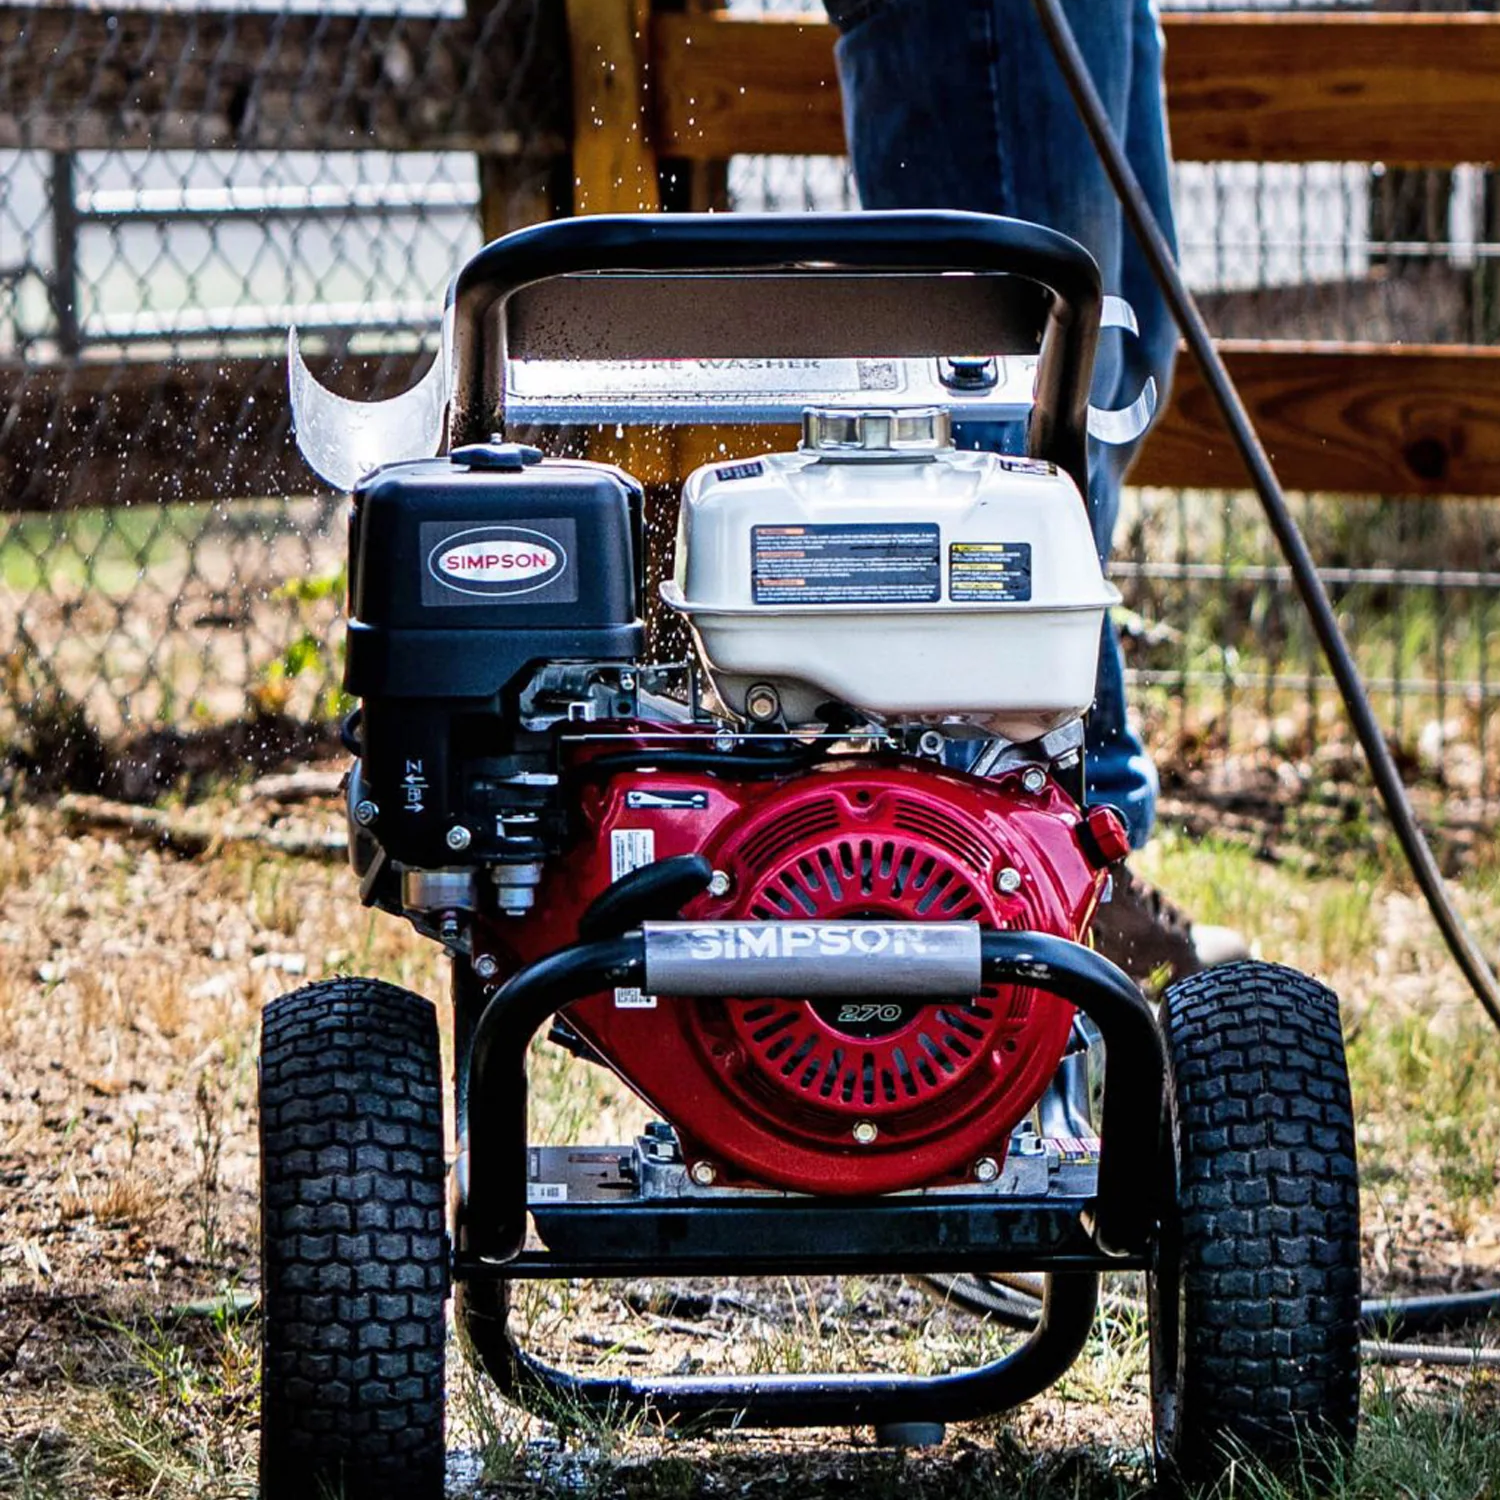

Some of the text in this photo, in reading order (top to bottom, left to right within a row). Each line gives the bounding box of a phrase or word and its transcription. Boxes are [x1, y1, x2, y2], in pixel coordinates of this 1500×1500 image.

[446, 553, 548, 570] SIMPSON
[690, 925, 928, 960] SIMPSON
[838, 1004, 902, 1022] 270
